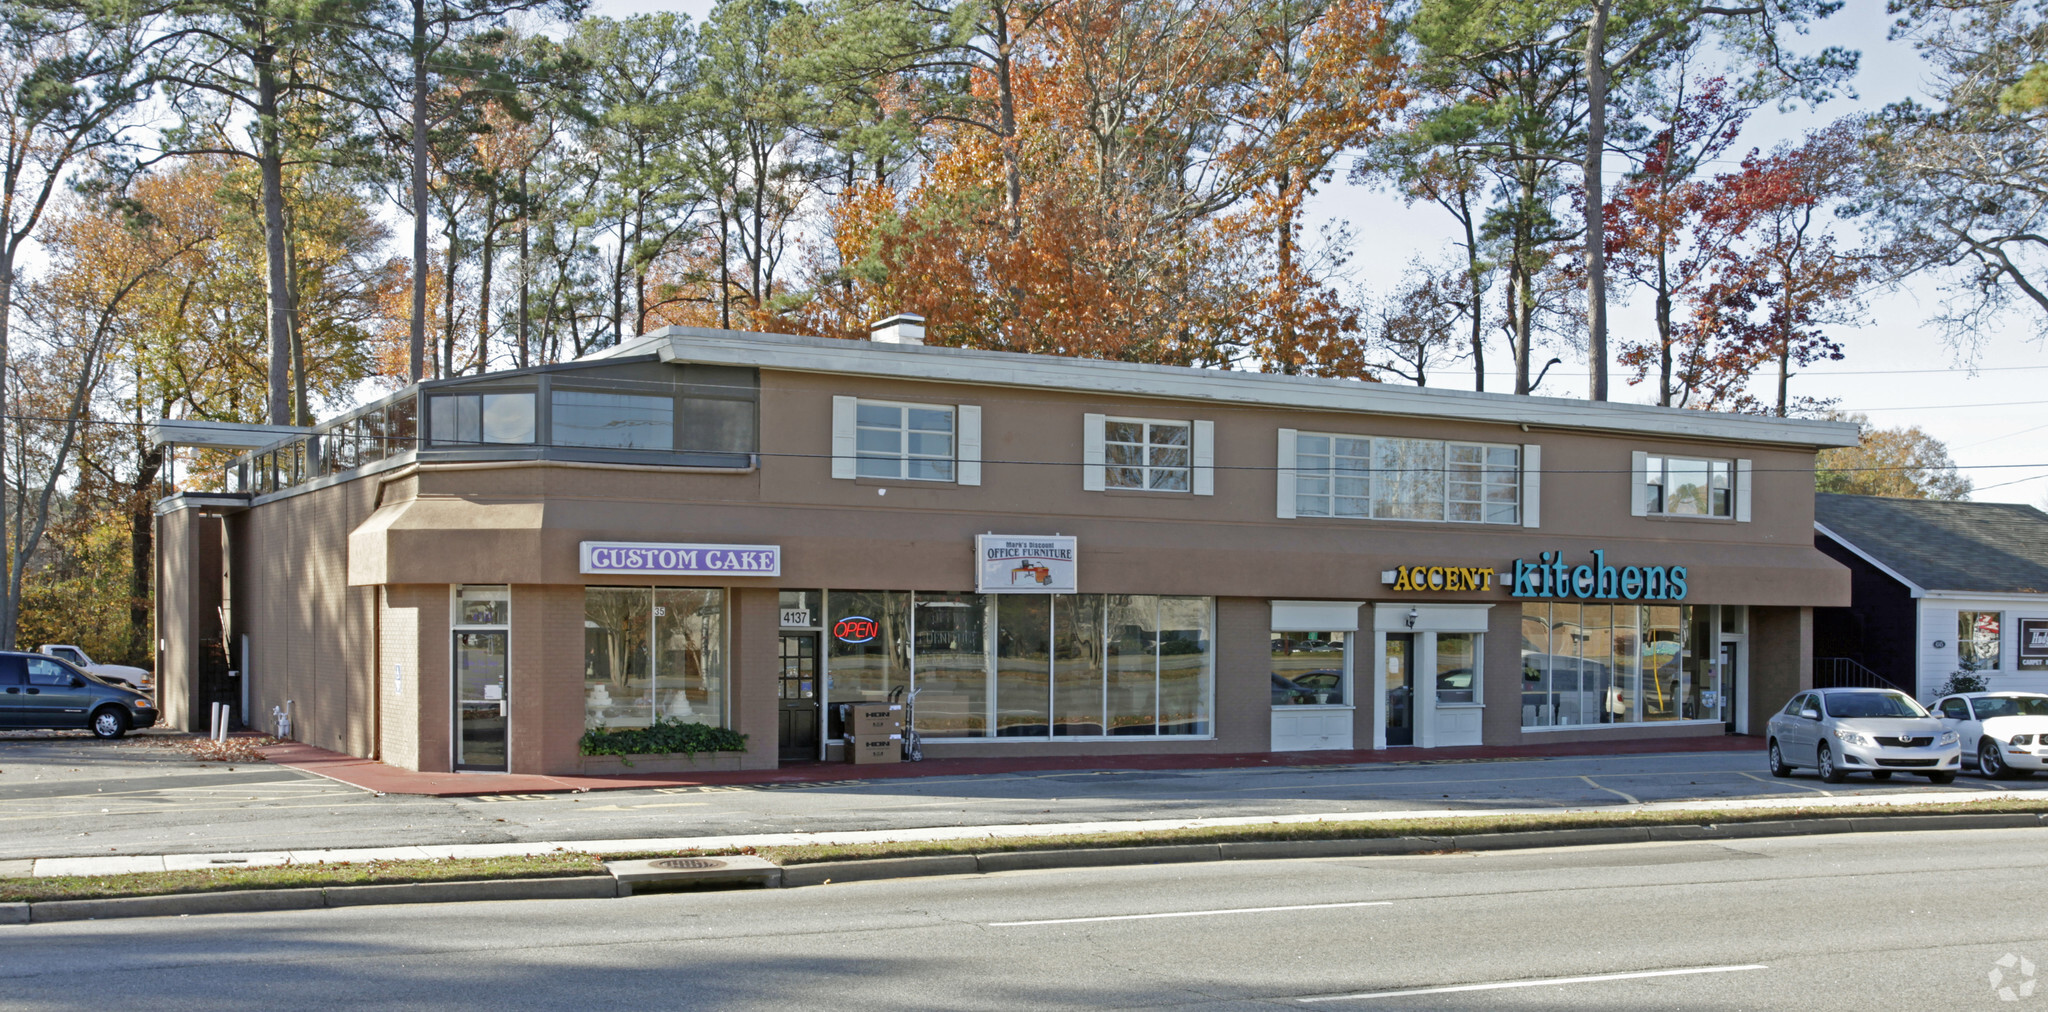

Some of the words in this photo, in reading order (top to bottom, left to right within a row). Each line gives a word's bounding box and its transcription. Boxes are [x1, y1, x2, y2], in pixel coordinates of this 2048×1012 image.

[592, 548, 698, 569] CUSTOM
[705, 551, 774, 571] CAKE
[987, 548, 1019, 559] OFFICE
[1022, 548, 1072, 559] FURNITURE
[1393, 565, 1494, 591] ACCENT
[1511, 549, 1687, 600] kitchens
[783, 612, 807, 624] 4137
[833, 622, 879, 638] OPEN
